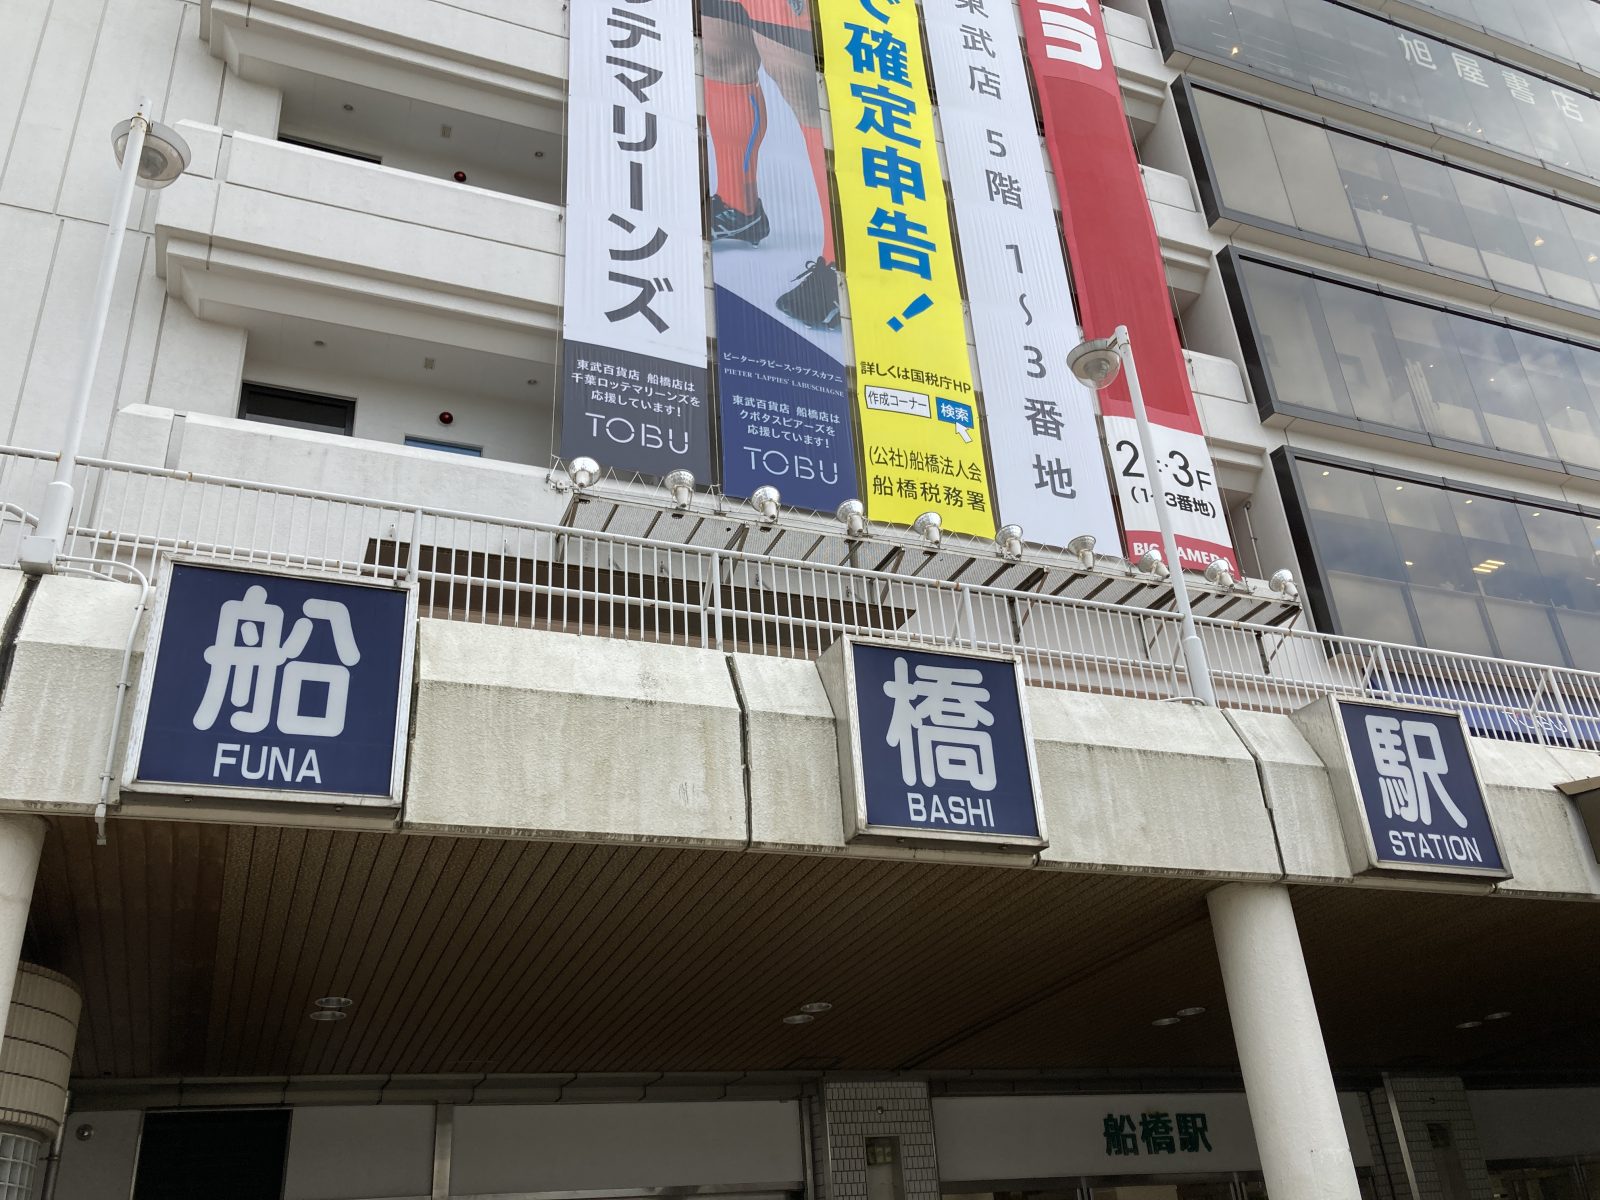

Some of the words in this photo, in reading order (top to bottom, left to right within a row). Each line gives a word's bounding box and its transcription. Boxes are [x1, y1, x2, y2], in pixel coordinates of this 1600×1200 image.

[1398, 33, 1584, 122] 旭屋書店
[604, 0, 674, 334] テマリーンズ
[571, 372, 701, 408] 千葉ロッテマリーンズを
[576, 359, 641, 381] 東武百貨店
[647, 373, 696, 392] 船橋店は
[723, 367, 753, 378] PIETER
[791, 381, 845, 398] LABUSCHAGNE
[860, 361, 971, 394] 詳しくは国税庁HP
[591, 389, 681, 417] 応援しています!
[732, 395, 790, 415] 東武百貨店
[796, 406, 841, 424] 船橋店は
[867, 390, 927, 410] 作成コーナー
[940, 402, 970, 423] 検索
[585, 412, 689, 454] TOBU
[747, 424, 830, 448] 応援しています!
[743, 446, 838, 485] TOBU
[869, 445, 982, 483] (公社)船橋法人会
[872, 475, 986, 513] 船橋税務署
[192, 584, 361, 737] 船
[883, 656, 997, 791] 橋
[213, 742, 322, 784] FUNA
[1365, 714, 1468, 829] 駅
[907, 792, 995, 827] BASHI
[1388, 829, 1482, 863] STATION
[1103, 1111, 1212, 1156] 船橋駅
